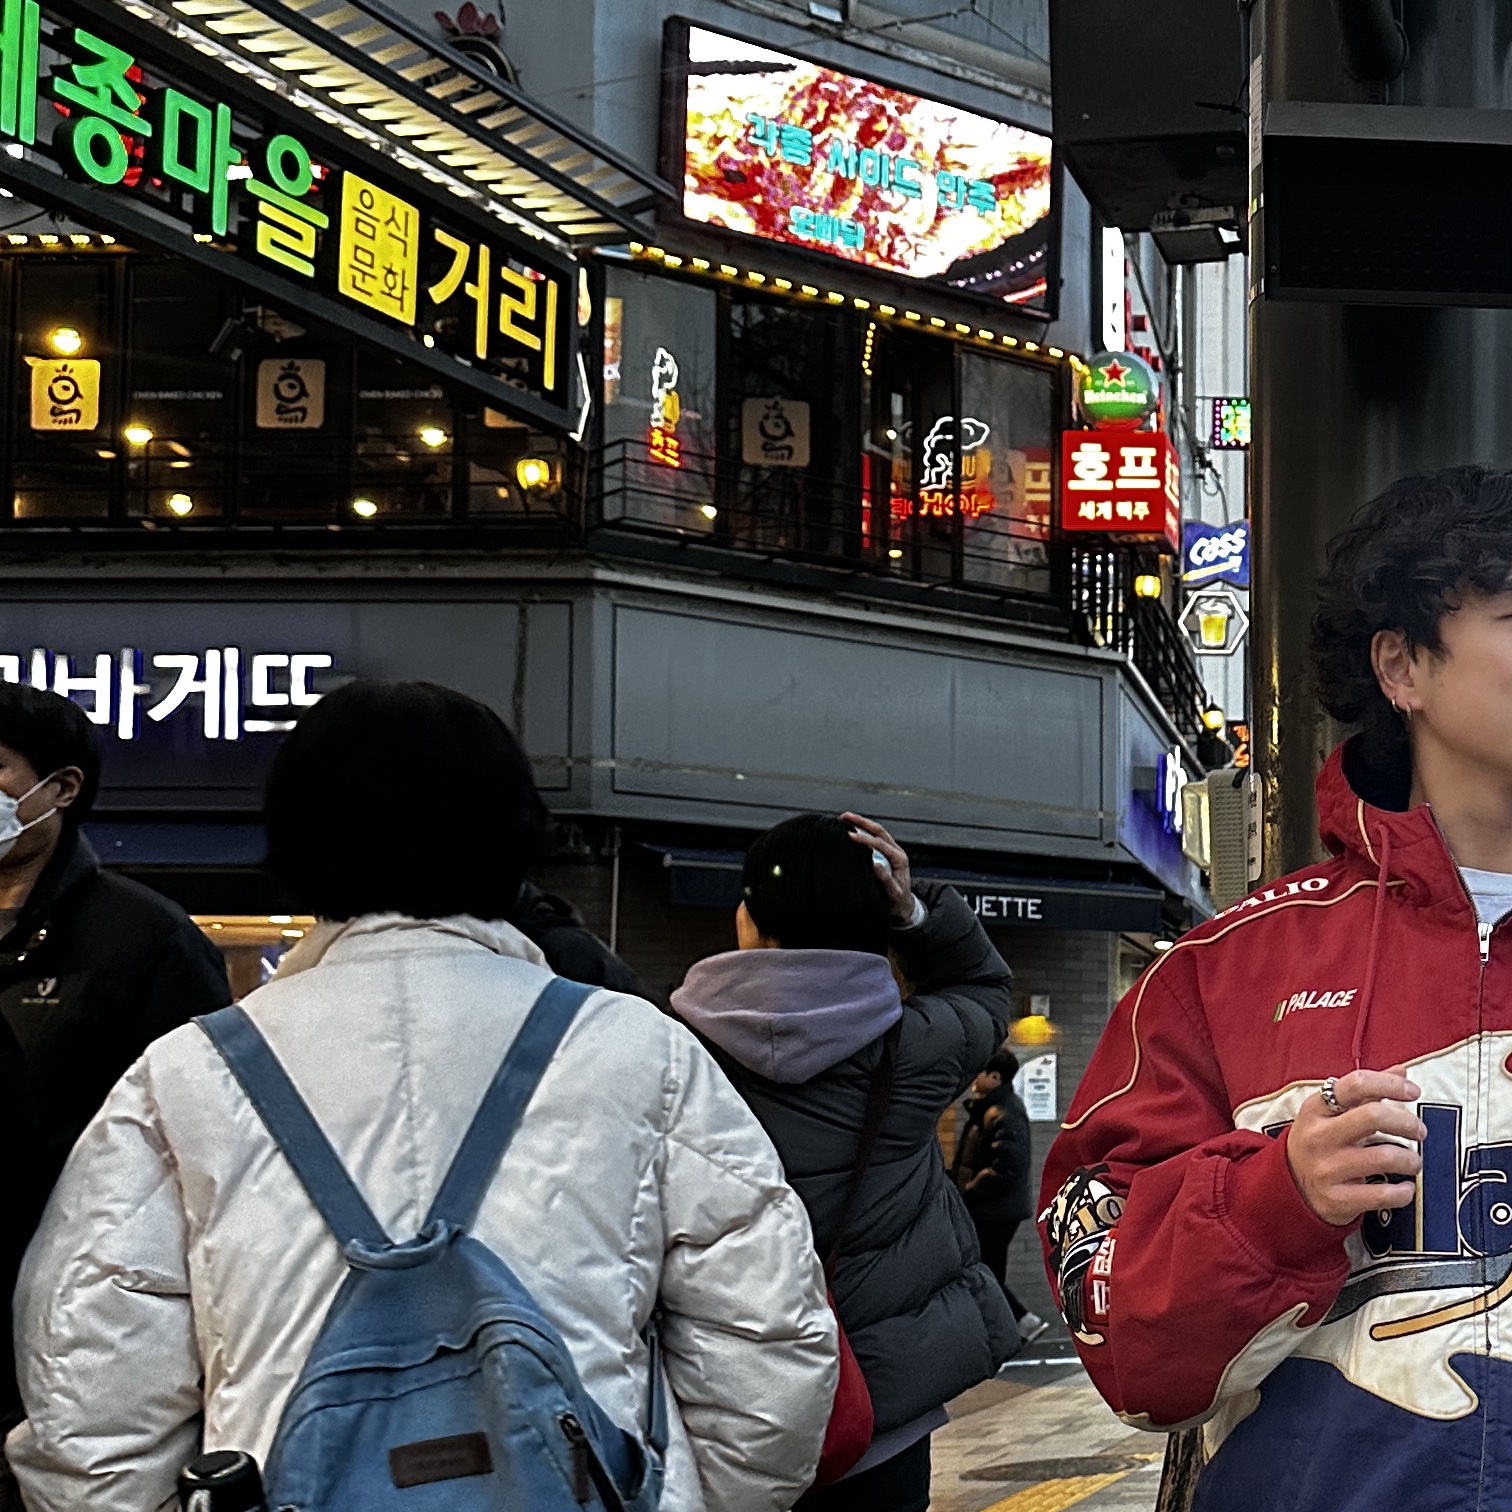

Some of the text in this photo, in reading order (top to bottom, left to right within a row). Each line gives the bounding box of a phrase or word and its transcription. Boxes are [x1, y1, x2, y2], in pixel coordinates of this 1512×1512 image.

[746, 111, 997, 216] 각종 사이드 안주
[352, 189, 410, 258] 음식
[350, 244, 410, 313] 문화
[428, 228, 558, 391] 거리
[1084, 389, 1148, 405] Heineken
[1067, 443, 1161, 491] 호프
[1285, 988, 1358, 1016] PALACE
